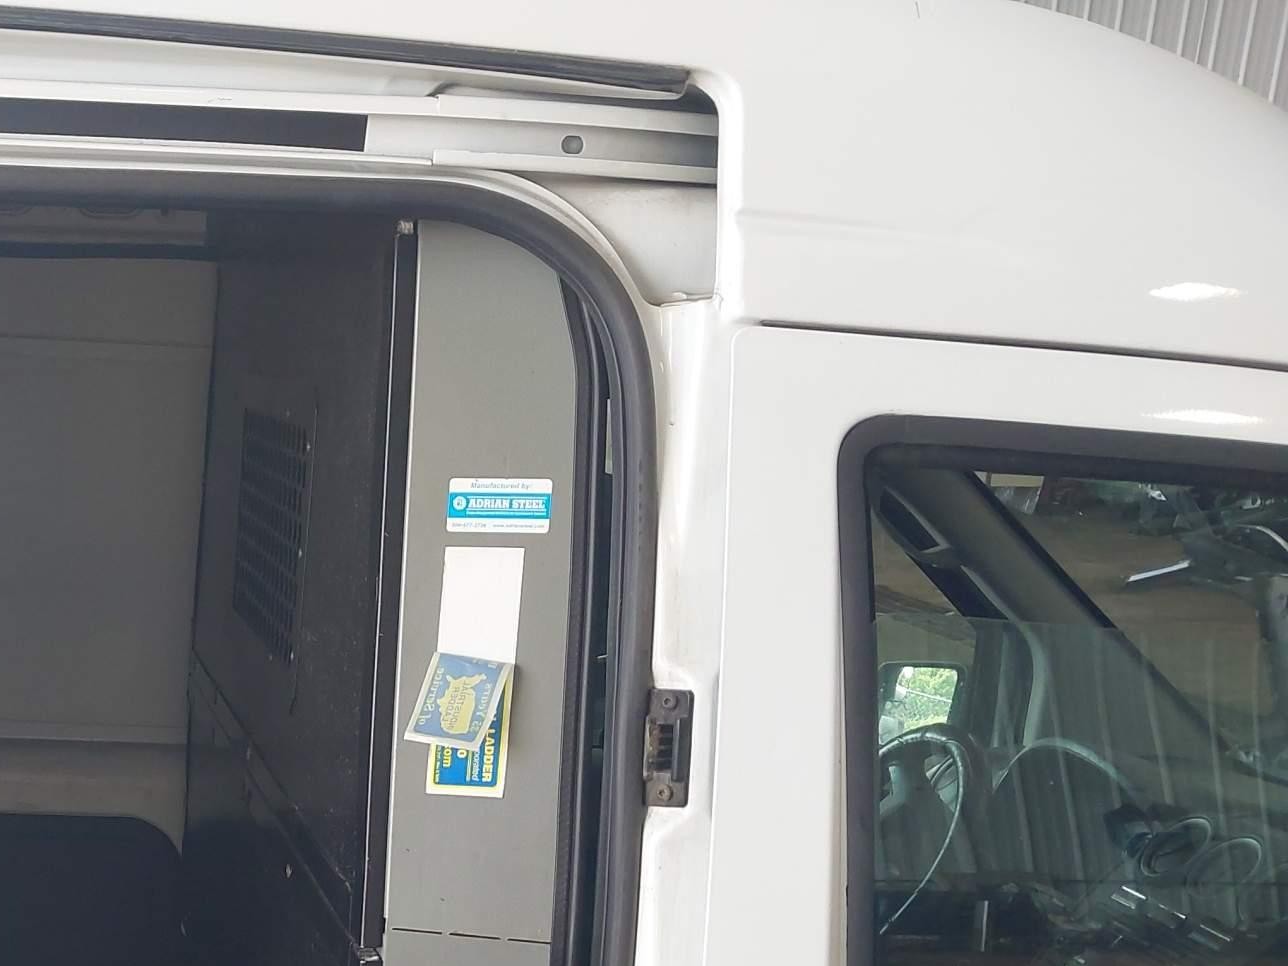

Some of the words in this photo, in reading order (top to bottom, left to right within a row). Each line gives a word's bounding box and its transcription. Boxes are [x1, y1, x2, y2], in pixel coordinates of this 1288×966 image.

[468, 498, 510, 509] ADRIAN
[512, 499, 546, 510] STEEL
[482, 728, 496, 783] LADDER
